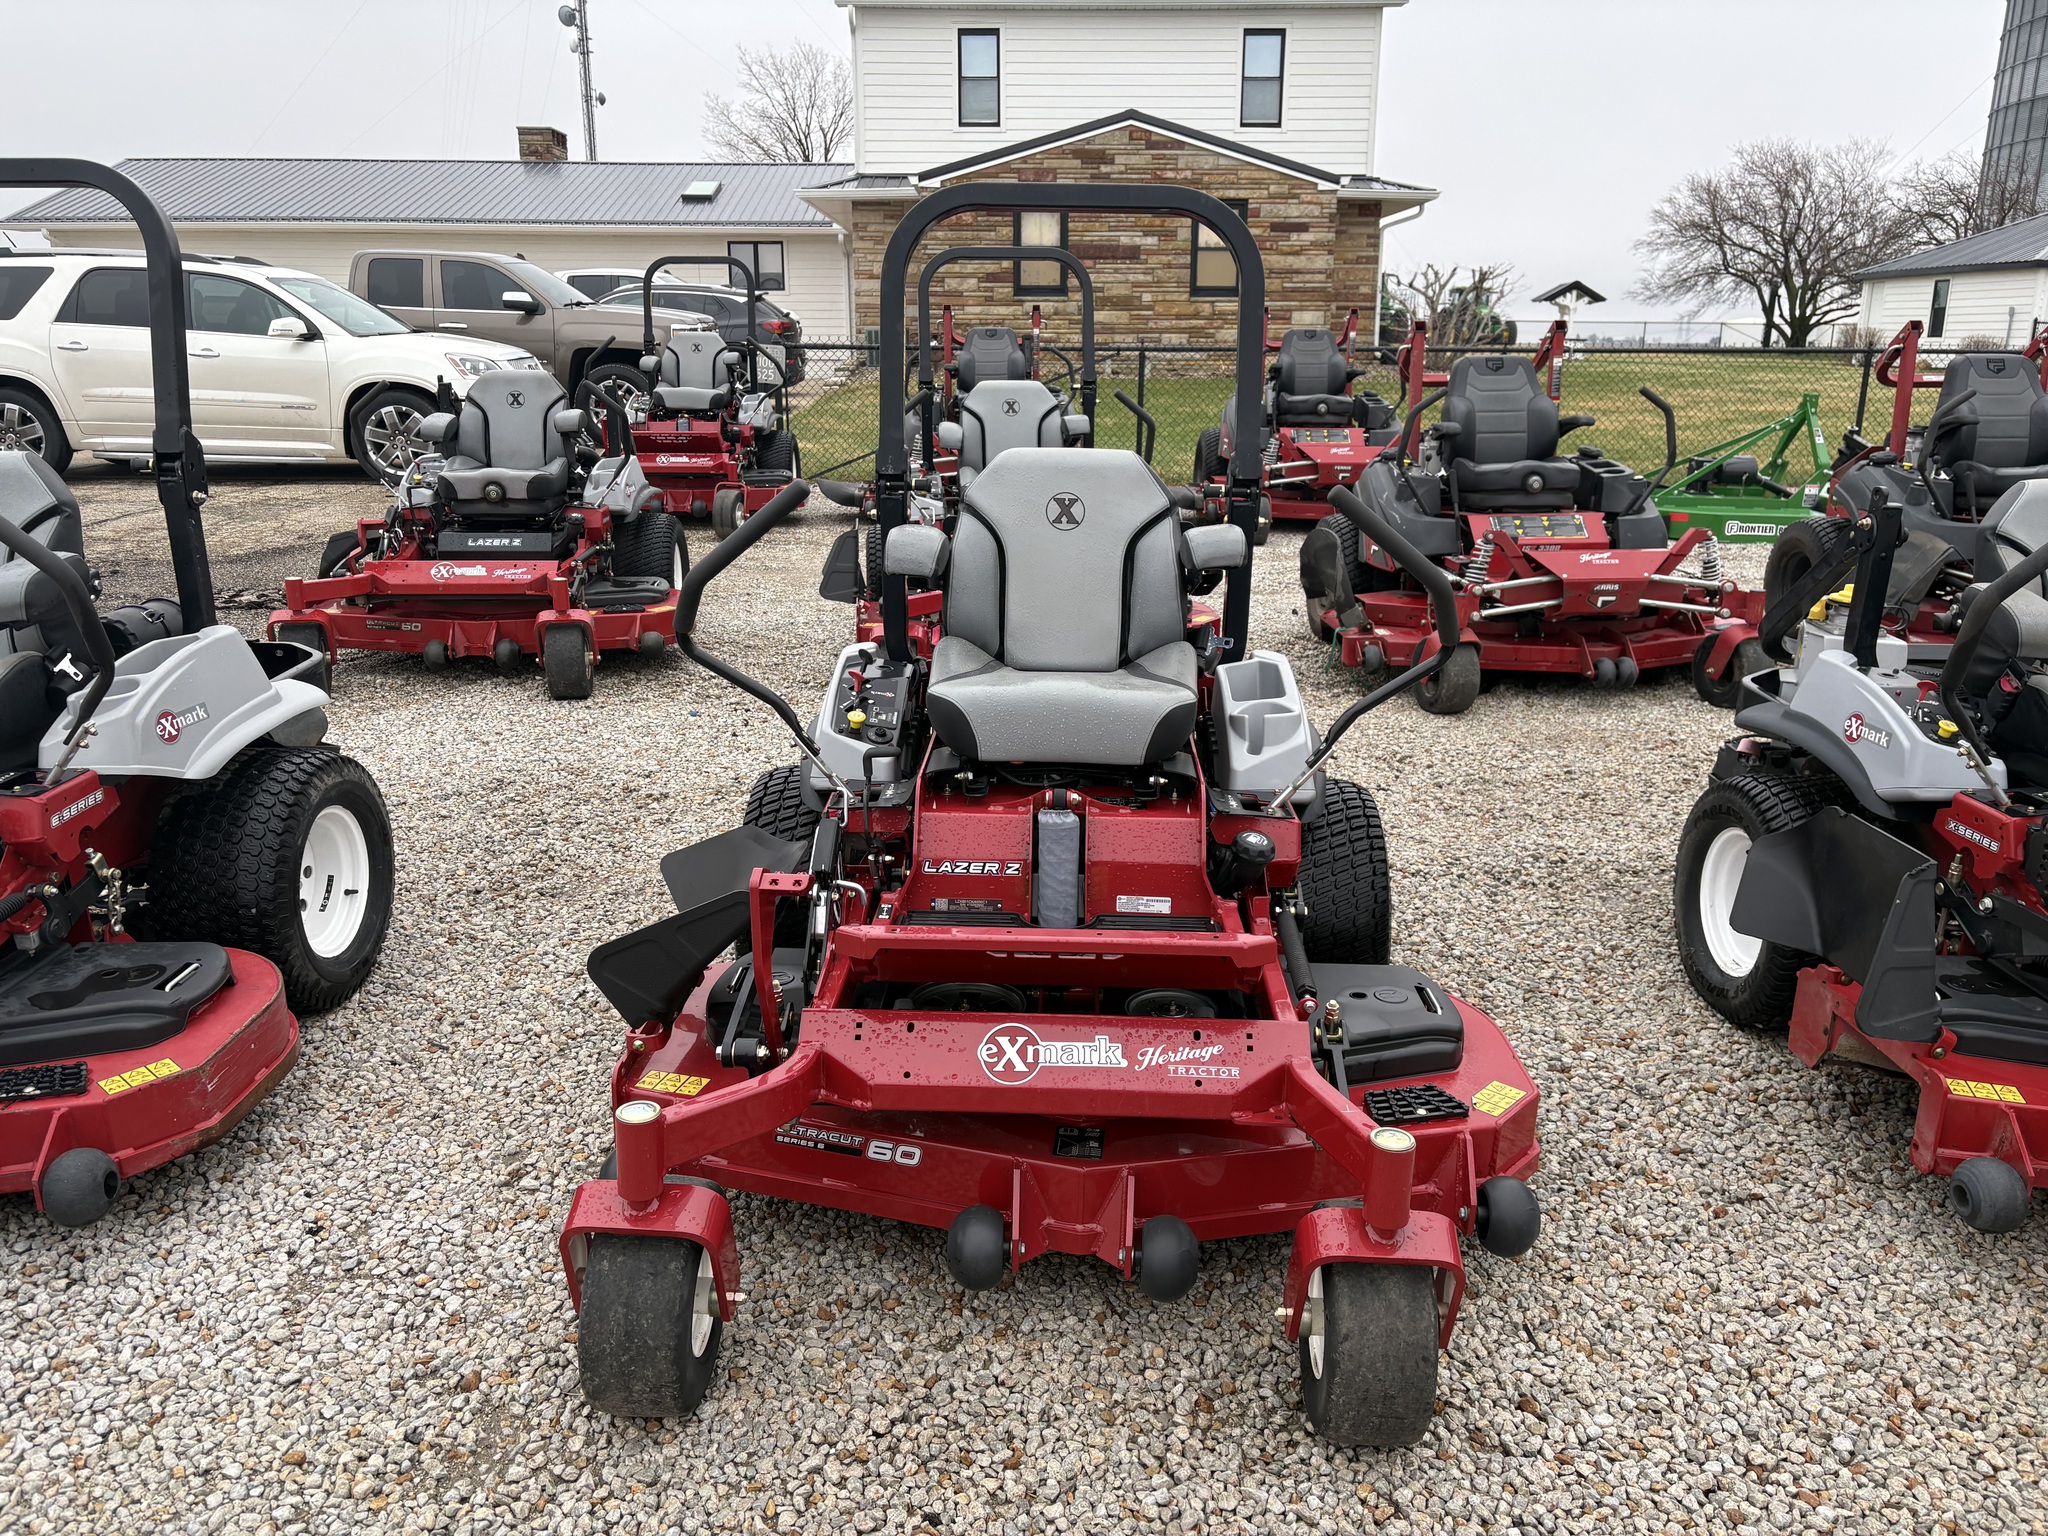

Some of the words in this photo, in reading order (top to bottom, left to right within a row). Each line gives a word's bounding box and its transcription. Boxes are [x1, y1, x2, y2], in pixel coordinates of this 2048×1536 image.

[508, 392, 523, 406] X
[1003, 401, 1019, 414] X
[1051, 497, 1080, 525] X
[1727, 522, 1775, 534] FRONTIER
[467, 538, 509, 546] LAZER
[511, 538, 522, 546] Z
[156, 704, 208, 741] eXmark
[1844, 715, 1889, 748] eXmark
[923, 860, 1000, 875] LAZER
[1003, 861, 1022, 875] Z
[979, 1033, 1125, 1075] eXmark
[1135, 1044, 1224, 1071] Heritage
[1168, 1066, 1240, 1077] TRACTOR
[776, 1135, 815, 1147] SERIES
[776, 1124, 864, 1147] TRACUT
[866, 1139, 922, 1167] 60
